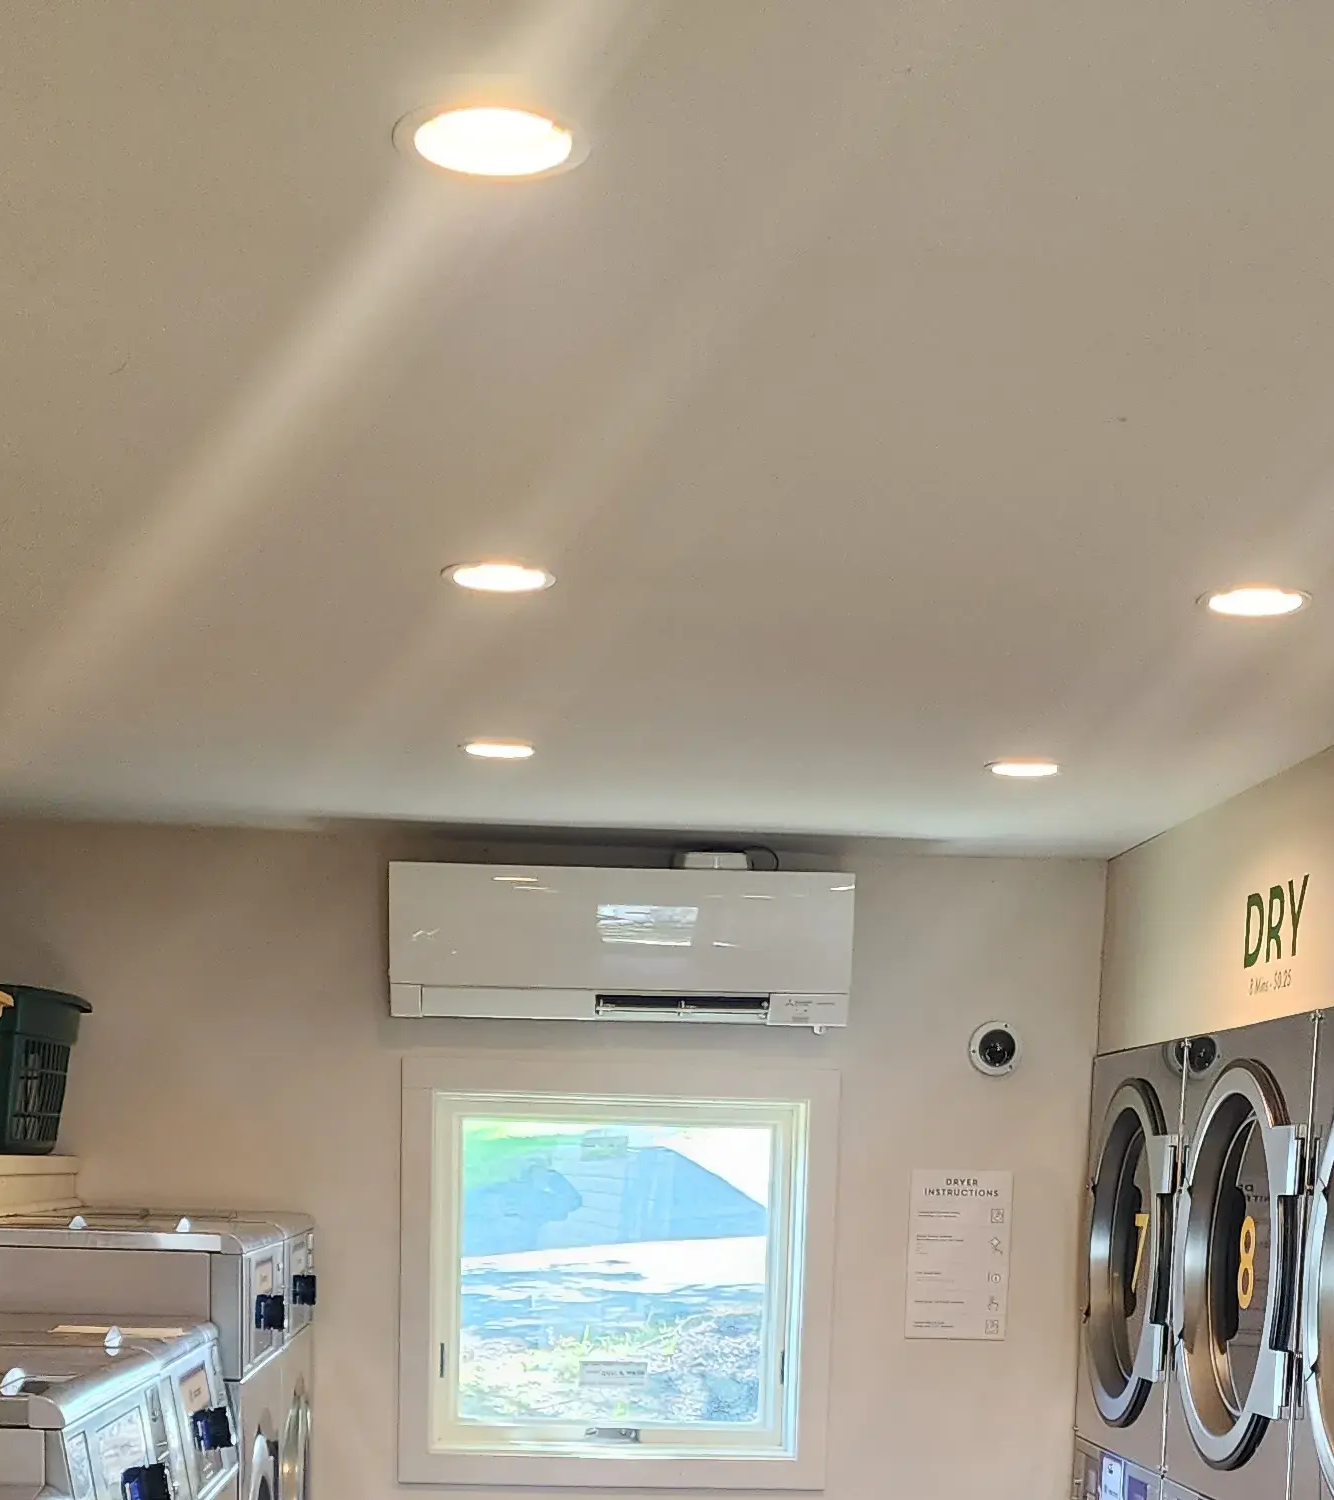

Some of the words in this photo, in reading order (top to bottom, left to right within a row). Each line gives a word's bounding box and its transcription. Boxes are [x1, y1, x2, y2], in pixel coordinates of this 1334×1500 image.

[1244, 873, 1309, 968] DRY
[924, 1188, 999, 1197] INSTRUCTIONS
[945, 1178, 979, 1187] DRYER
[1132, 1213, 1150, 1294] 7
[1237, 1215, 1256, 1310] 8
